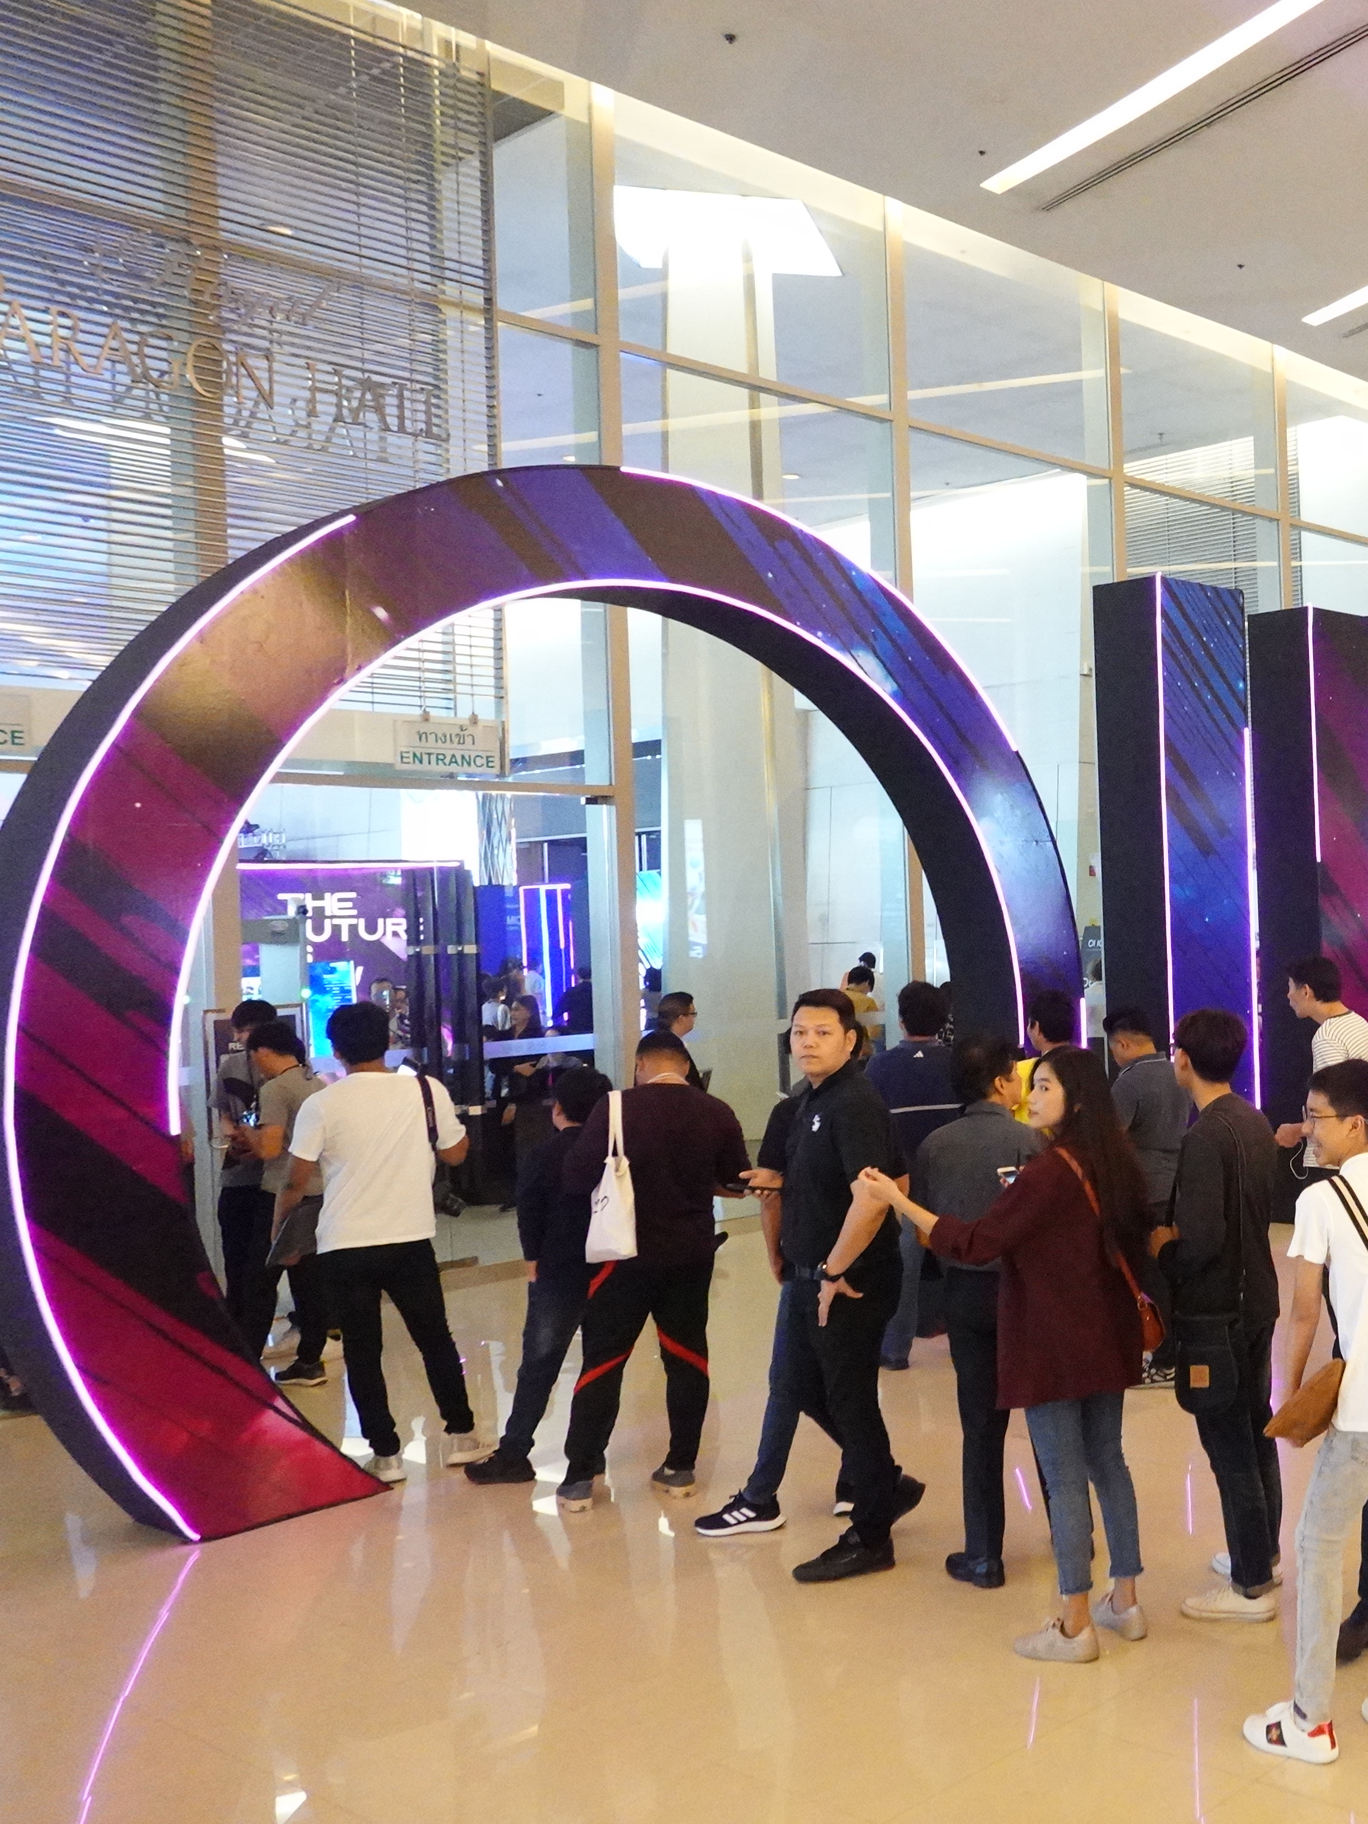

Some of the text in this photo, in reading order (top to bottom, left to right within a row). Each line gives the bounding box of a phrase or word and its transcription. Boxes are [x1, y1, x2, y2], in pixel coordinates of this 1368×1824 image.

[306, 361, 451, 441] HALL
[416, 724, 476, 746] ทางเข้า
[400, 750, 496, 769] ENTRANCE
[277, 891, 358, 917] THE
